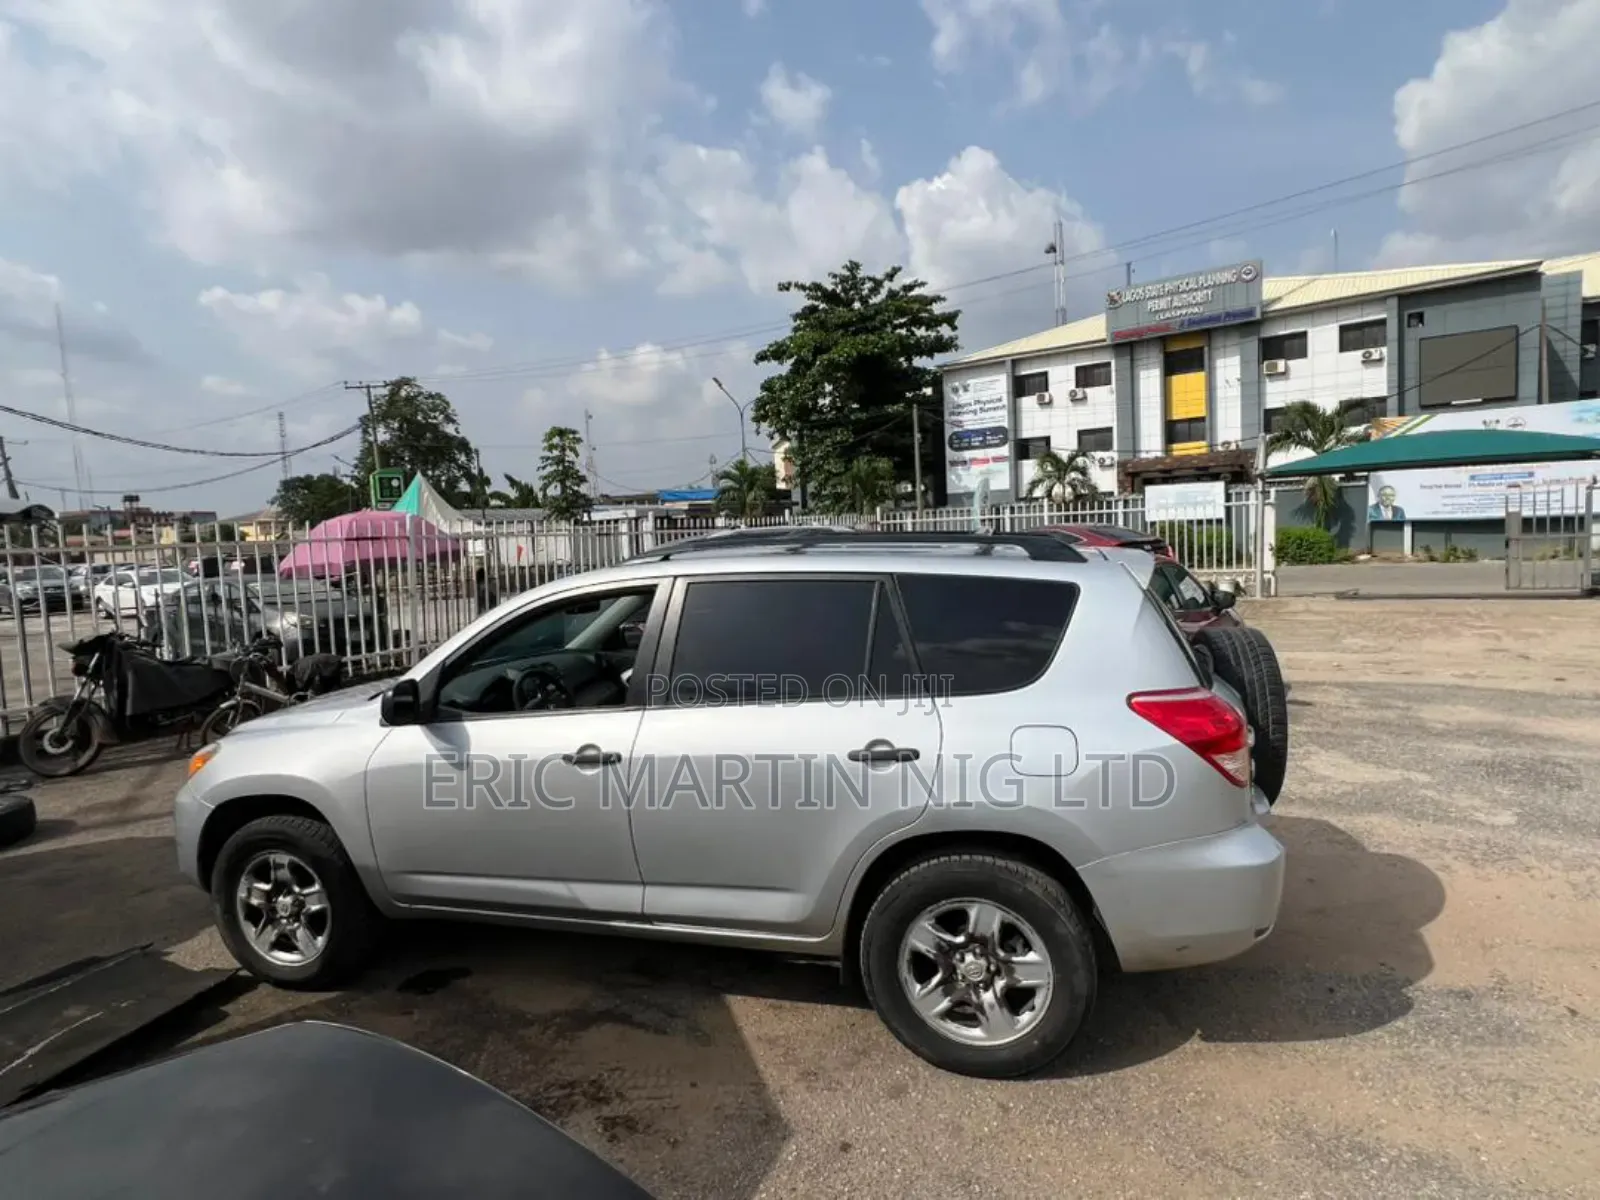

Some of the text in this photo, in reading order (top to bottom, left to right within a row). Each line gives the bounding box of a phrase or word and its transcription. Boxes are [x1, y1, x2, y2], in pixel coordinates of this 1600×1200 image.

[1122, 269, 1238, 302] LAGOS STATE PHYSICAL PLANNING
[1148, 289, 1212, 311] PERMIT AUTHORITY
[974, 396, 1002, 406] Physical
[979, 404, 1005, 414] Summit
